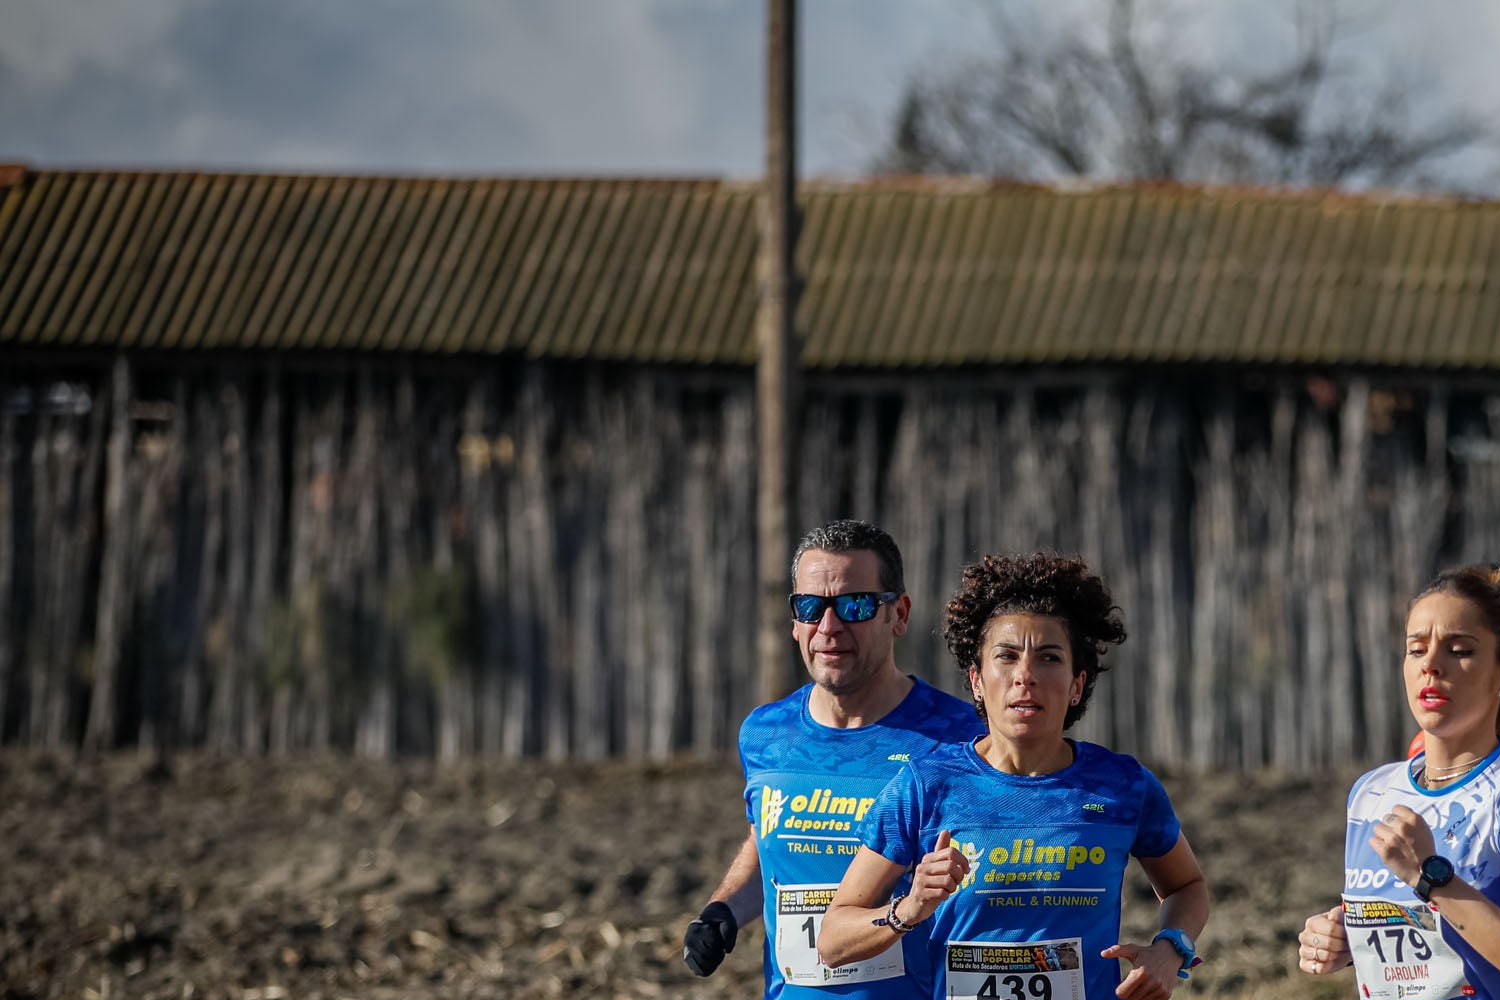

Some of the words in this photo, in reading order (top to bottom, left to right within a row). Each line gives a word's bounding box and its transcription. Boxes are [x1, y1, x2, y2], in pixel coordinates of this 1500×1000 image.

[784, 815, 851, 832] deportes
[787, 842, 822, 854] TRAIL
[826, 844, 834, 855] &
[989, 838, 1105, 870] olimpo
[984, 869, 1061, 885] deportes
[988, 896, 1026, 907] TRAIL
[1030, 896, 1039, 906] &
[1043, 895, 1098, 907] RUNNING
[1367, 928, 1432, 963] 179
[951, 948, 963, 958] 26
[982, 948, 1031, 957] CARRERA
[983, 956, 1031, 964] POPULAR
[833, 967, 859, 975] olimpo
[1384, 964, 1429, 982] CAROLINA
